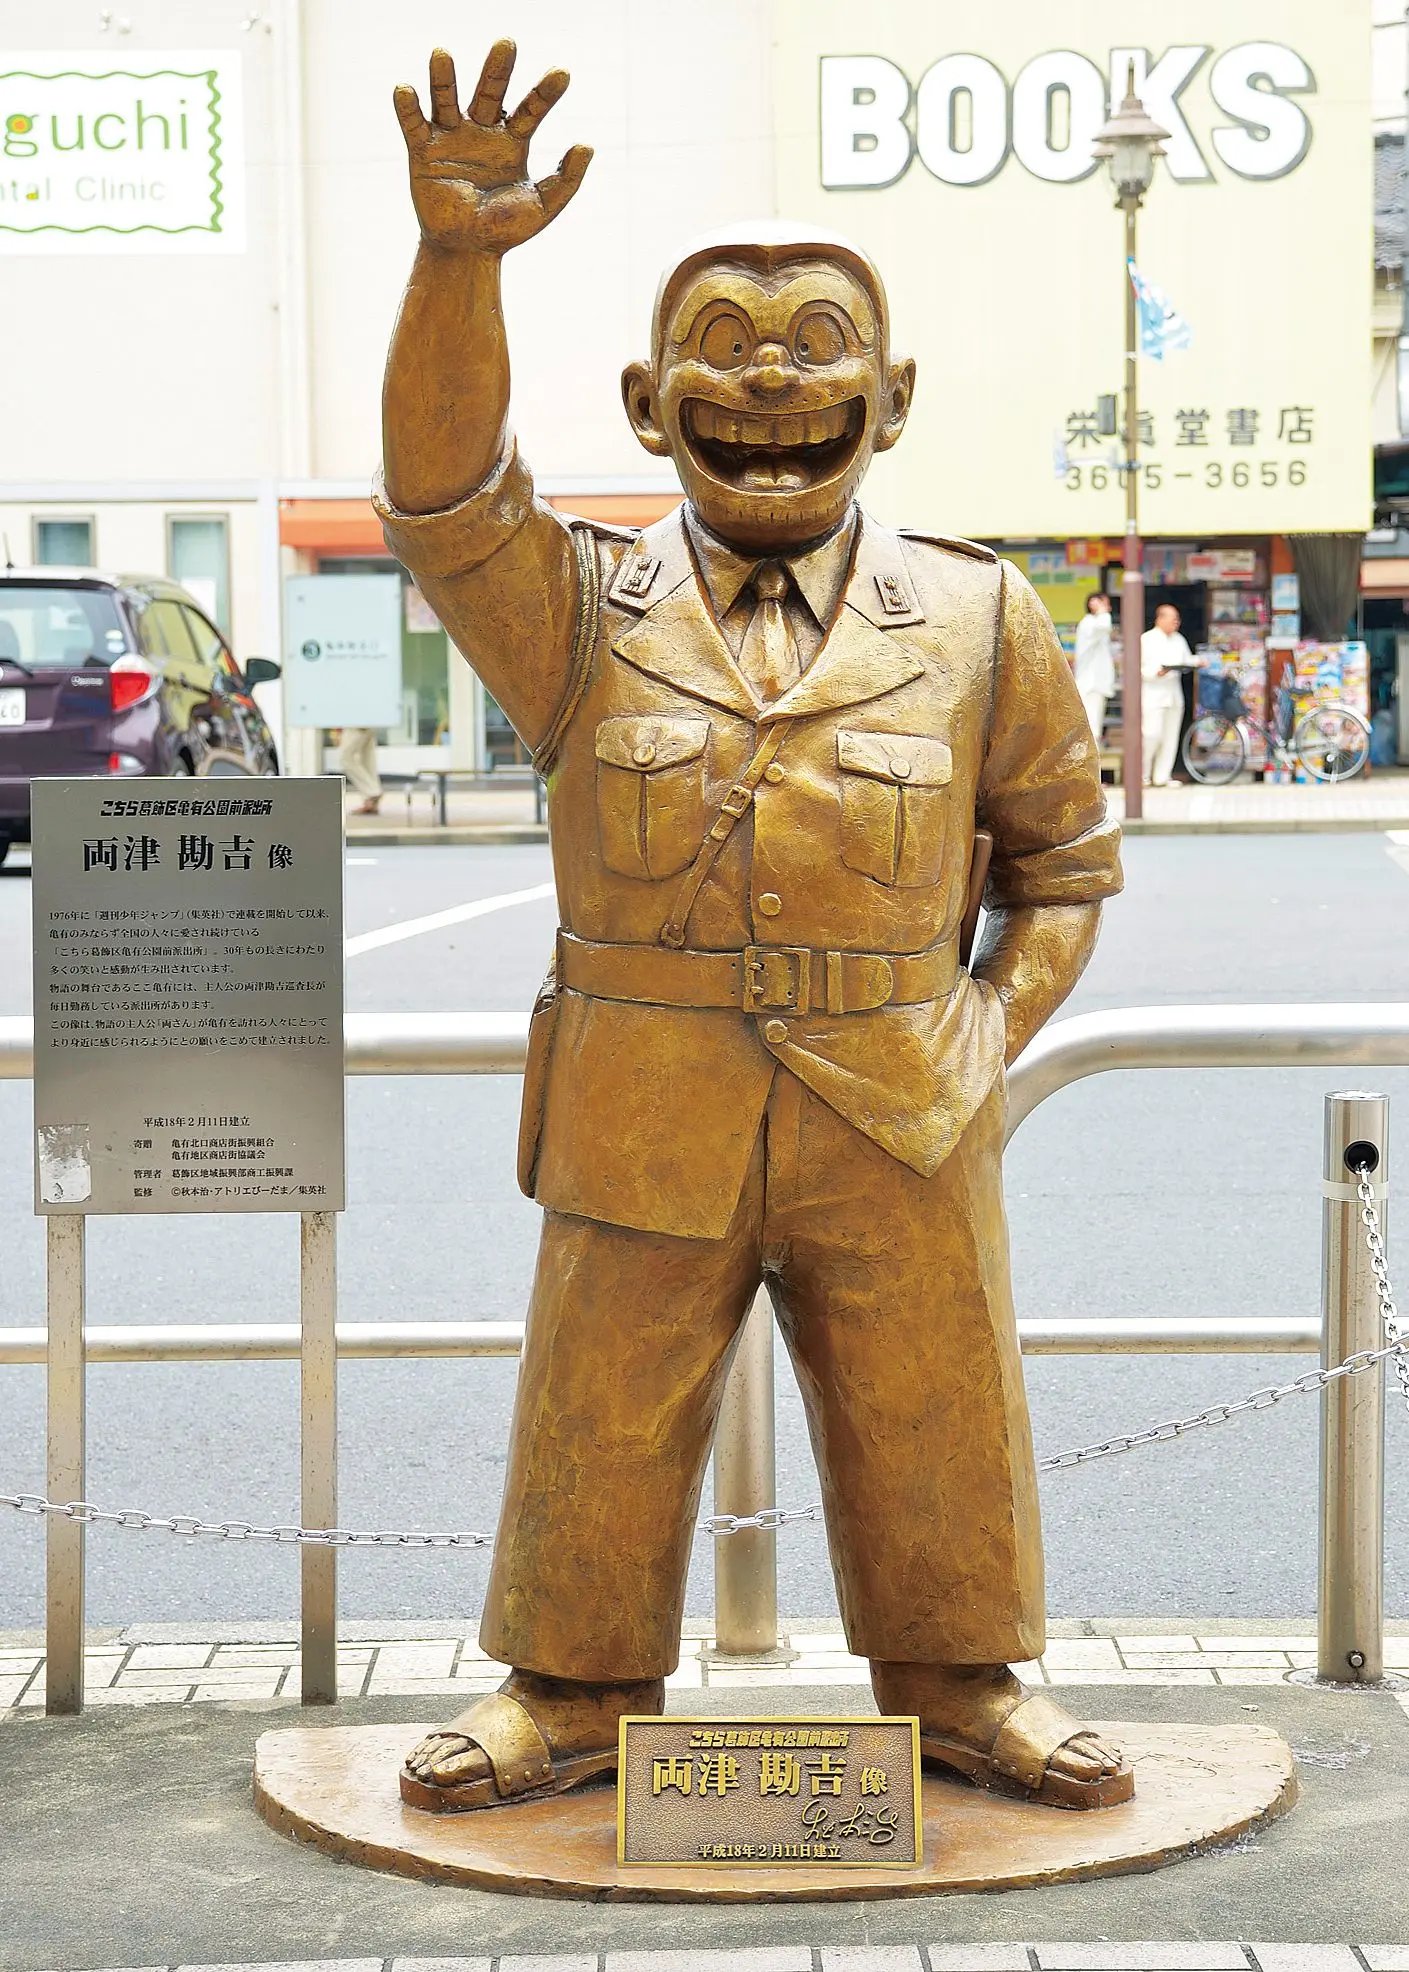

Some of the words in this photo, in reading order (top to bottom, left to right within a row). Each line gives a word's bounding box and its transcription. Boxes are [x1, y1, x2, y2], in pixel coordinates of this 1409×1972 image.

[820, 40, 1317, 191] BOOKS
[3, 99, 188, 157] guchi
[74, 176, 167, 201] Clinic
[100, 799, 274, 817] こちら葛飾区亀有公園前派出所
[82, 835, 161, 872] 両津
[177, 835, 256, 872] 勘吉
[267, 843, 294, 870] 像
[49, 927, 260, 939] 亀有のみならず全国の人々に愛され続けている
[50, 962, 234, 975] 多くの笑いと感動が生み出されています。
[50, 1000, 214, 1012] 毎日勤務している派出所があります。
[50, 1036, 330, 1048] より身近に感じられるようにとの願いをこめて建立されました。
[133, 1139, 153, 1149] 寄贈
[171, 1138, 275, 1149] 亀有北口商店街振興組合
[171, 1150, 266, 1161] 亀有地区商店街協議会
[133, 1169, 162, 1179] 管理者
[171, 1168, 294, 1179] 葛飾区地域振興部商工振興課
[133, 1187, 153, 1198] 監修
[689, 1730, 849, 1748] こちら葛飾区亀有公園前派出所
[652, 1753, 741, 1796] 両津
[758, 1752, 847, 1796] 勘吉
[860, 1766, 889, 1796] 像
